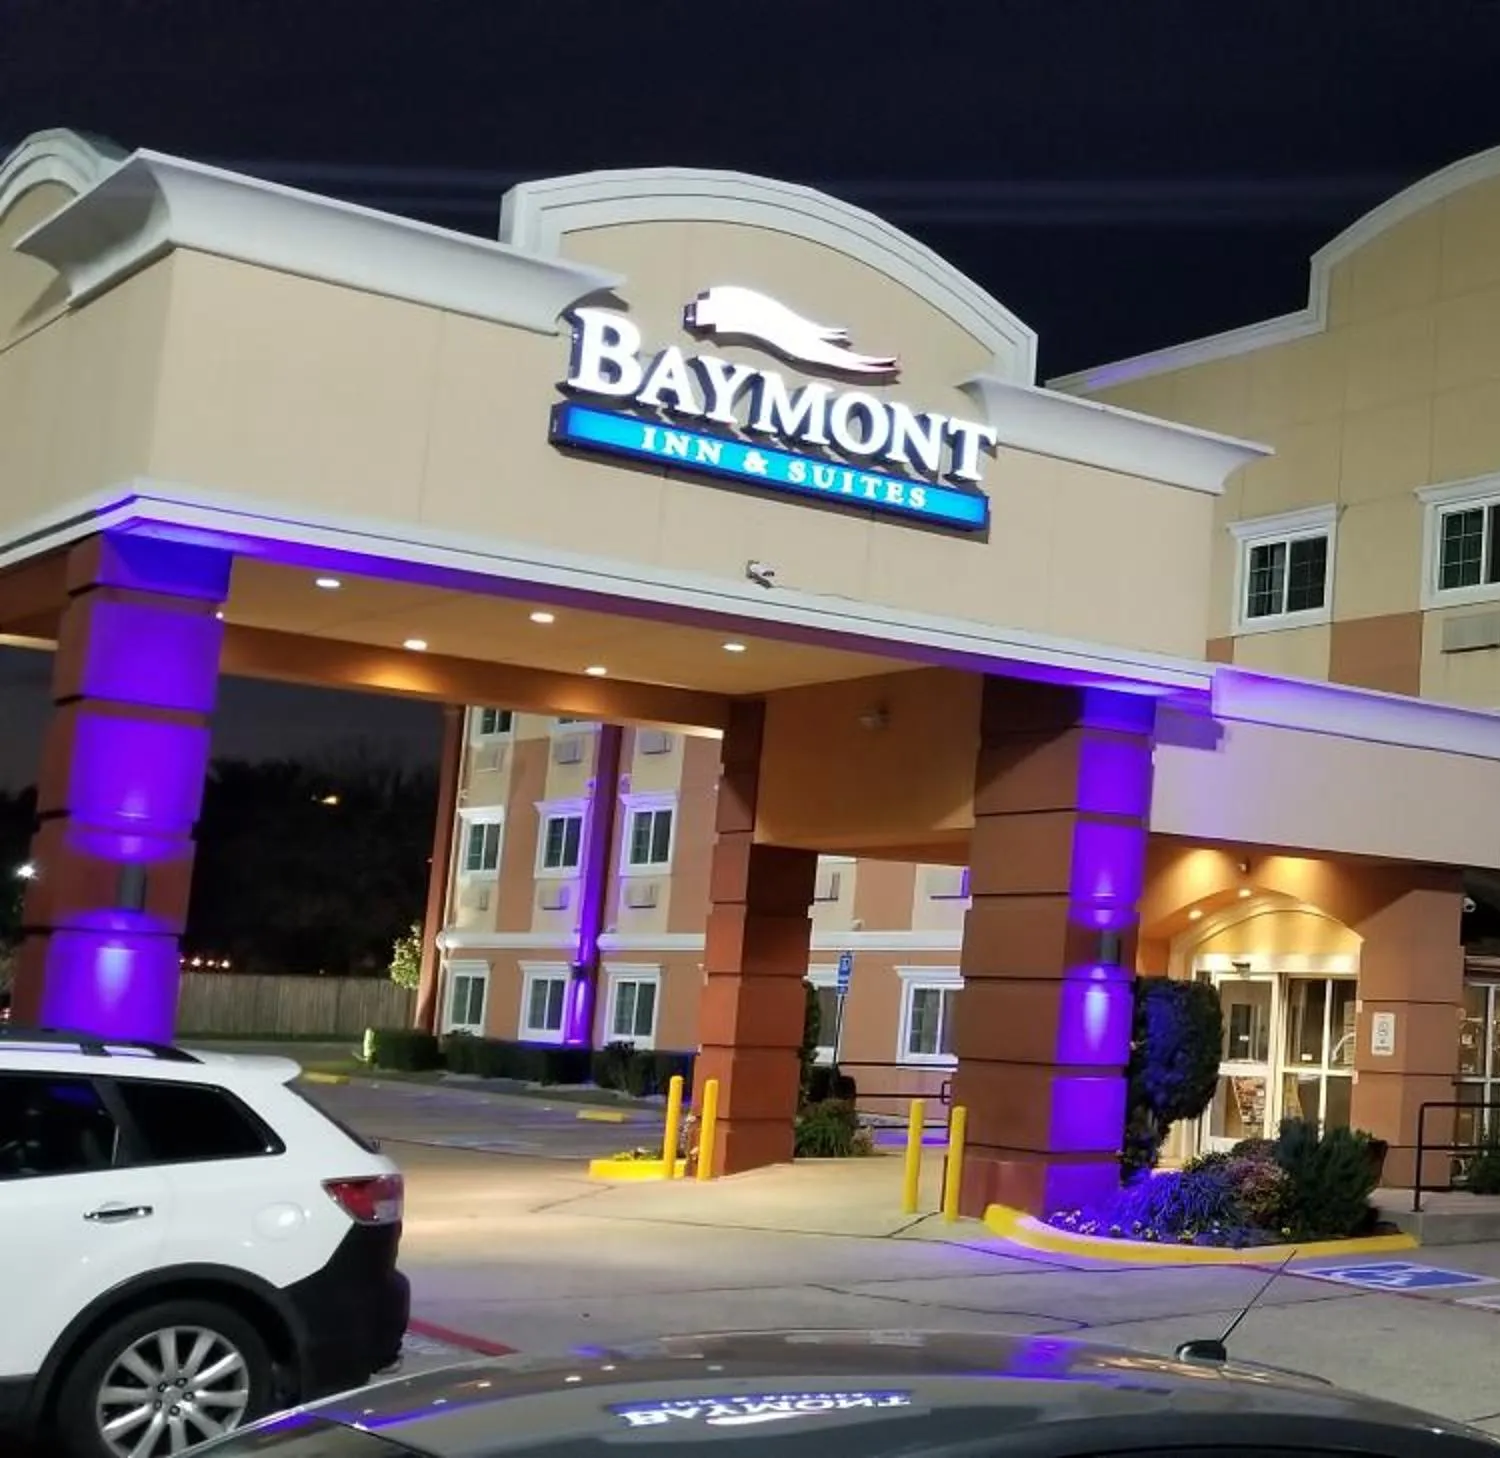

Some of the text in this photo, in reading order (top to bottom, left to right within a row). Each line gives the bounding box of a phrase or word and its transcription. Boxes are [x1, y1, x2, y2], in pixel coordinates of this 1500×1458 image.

[567, 307, 998, 481] BAYMONT
[640, 426, 928, 510] INN & SUITES
